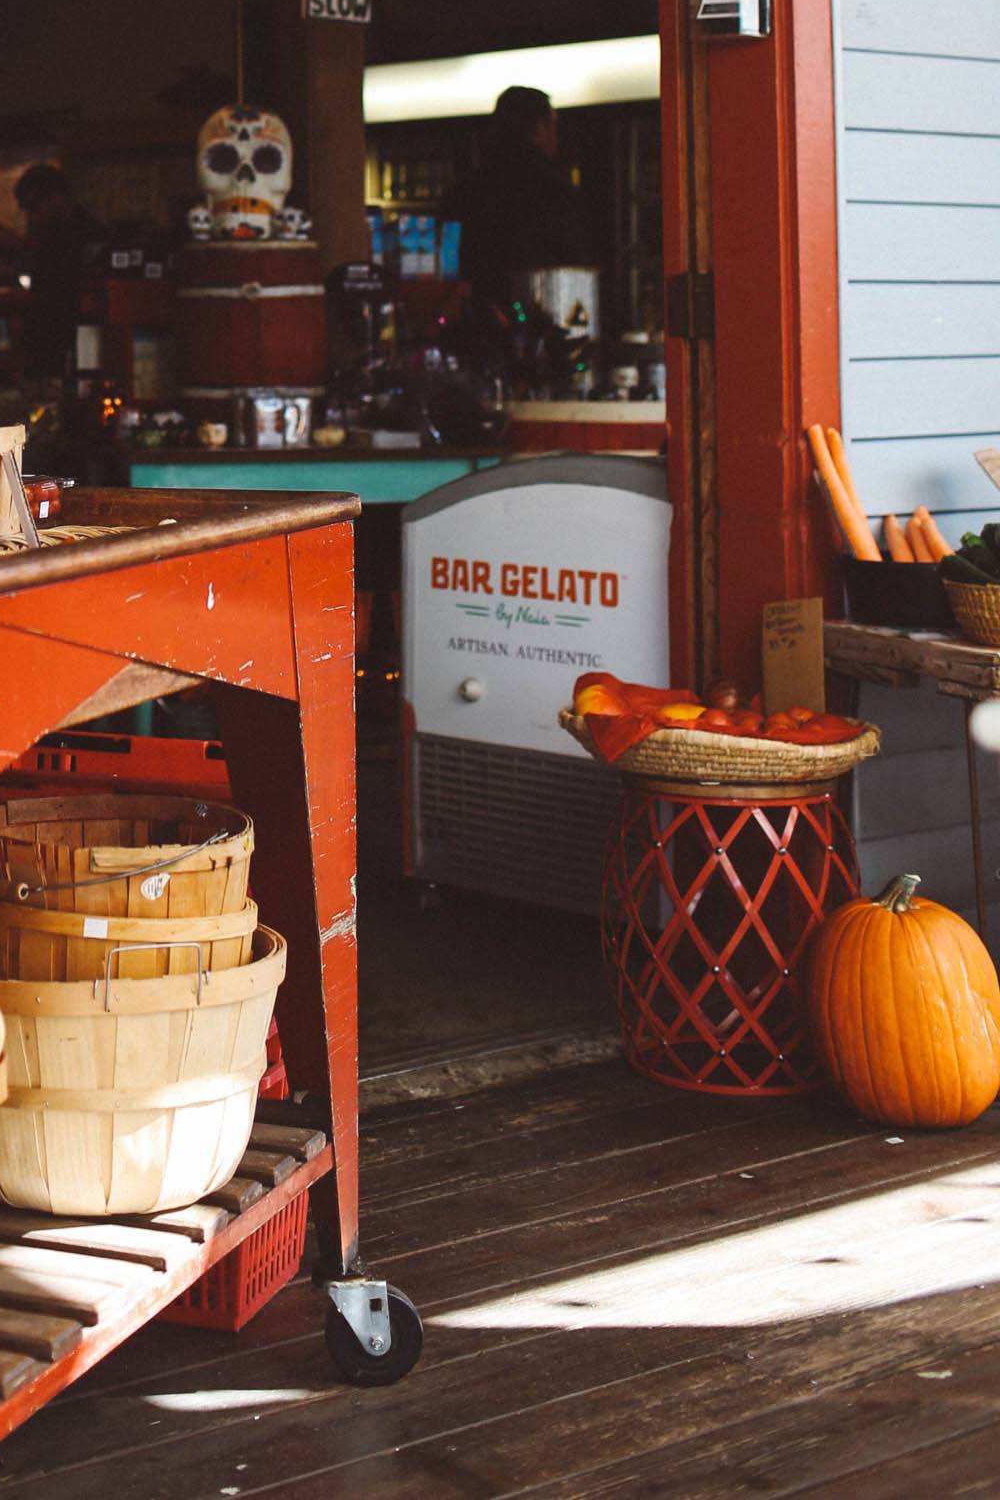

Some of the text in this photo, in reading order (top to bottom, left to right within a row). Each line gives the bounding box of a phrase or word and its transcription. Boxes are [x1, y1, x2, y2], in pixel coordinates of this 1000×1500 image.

[431, 557, 619, 608] BAR GELATO
[495, 602, 550, 629] by Naia
